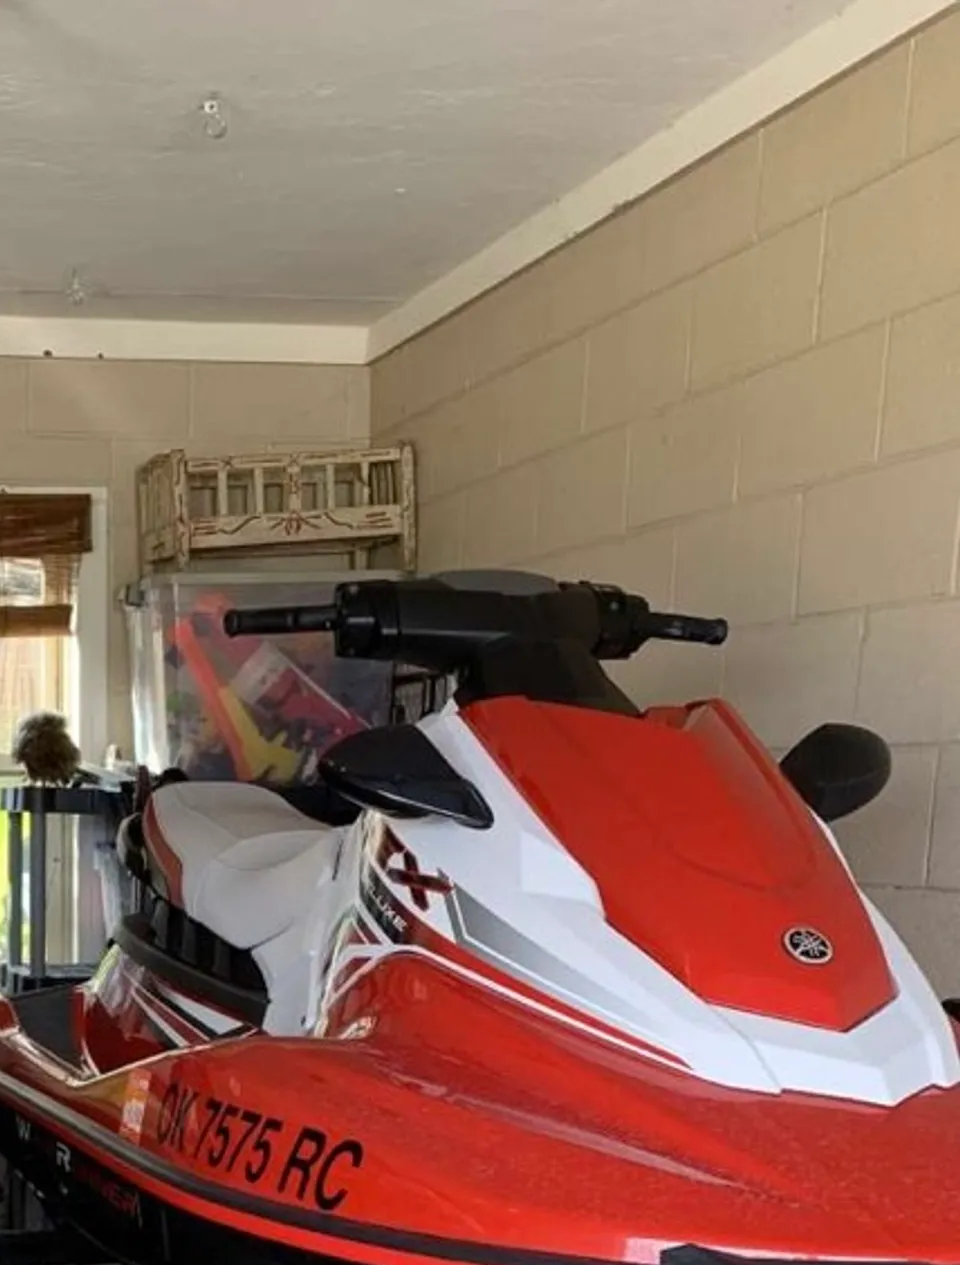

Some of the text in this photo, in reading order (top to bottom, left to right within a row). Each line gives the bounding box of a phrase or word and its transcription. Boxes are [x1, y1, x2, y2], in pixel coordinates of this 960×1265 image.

[156, 1083, 363, 1211] OK 7575 RC
